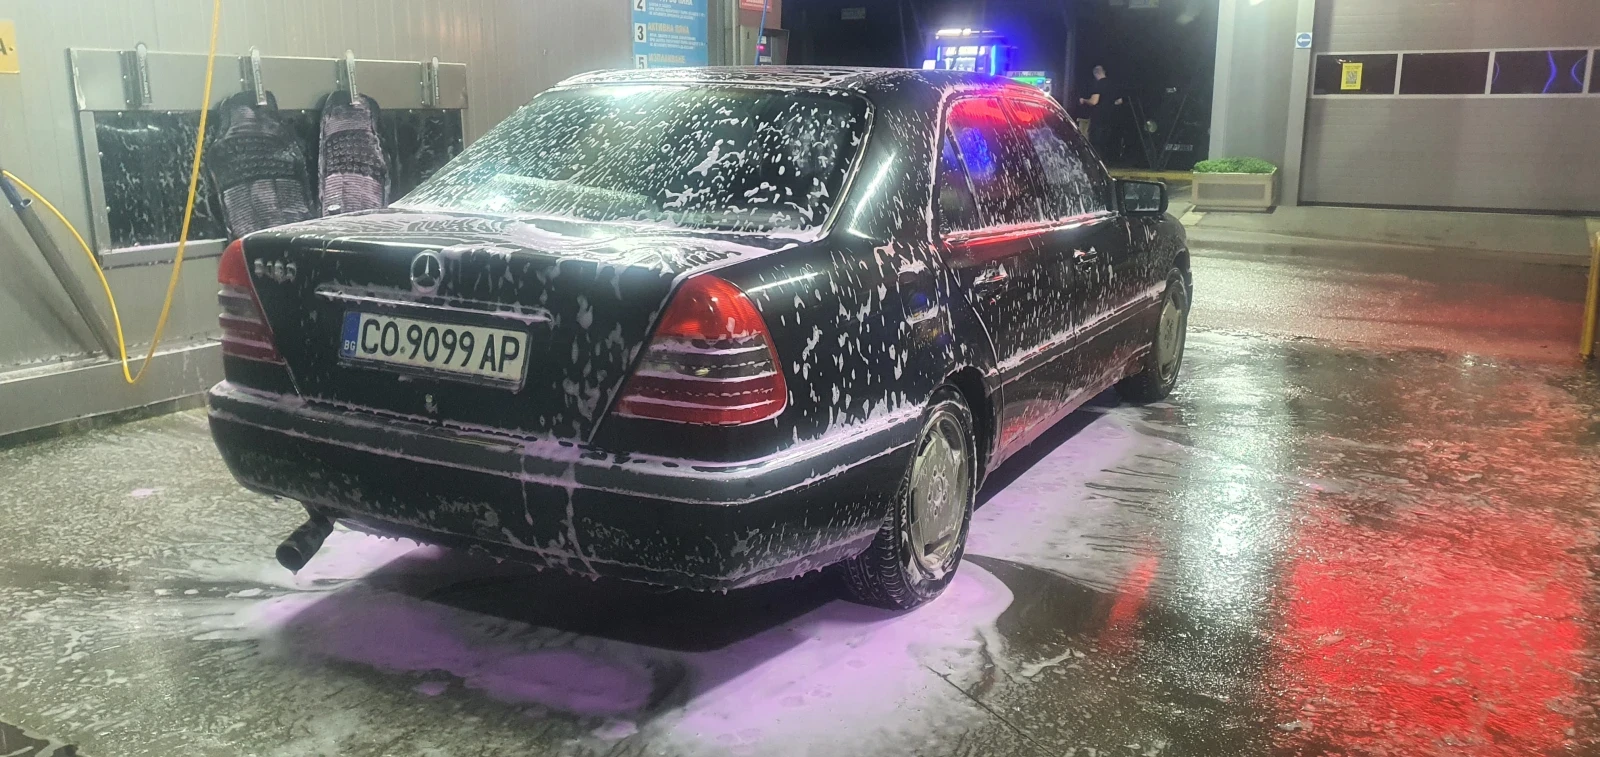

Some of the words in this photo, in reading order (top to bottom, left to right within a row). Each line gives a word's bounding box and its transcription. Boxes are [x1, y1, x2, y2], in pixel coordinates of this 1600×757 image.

[637, 25, 644, 41] 3
[343, 339, 356, 351] BG
[361, 318, 400, 357] CO
[407, 324, 475, 367] 9099
[479, 333, 520, 373] AP
